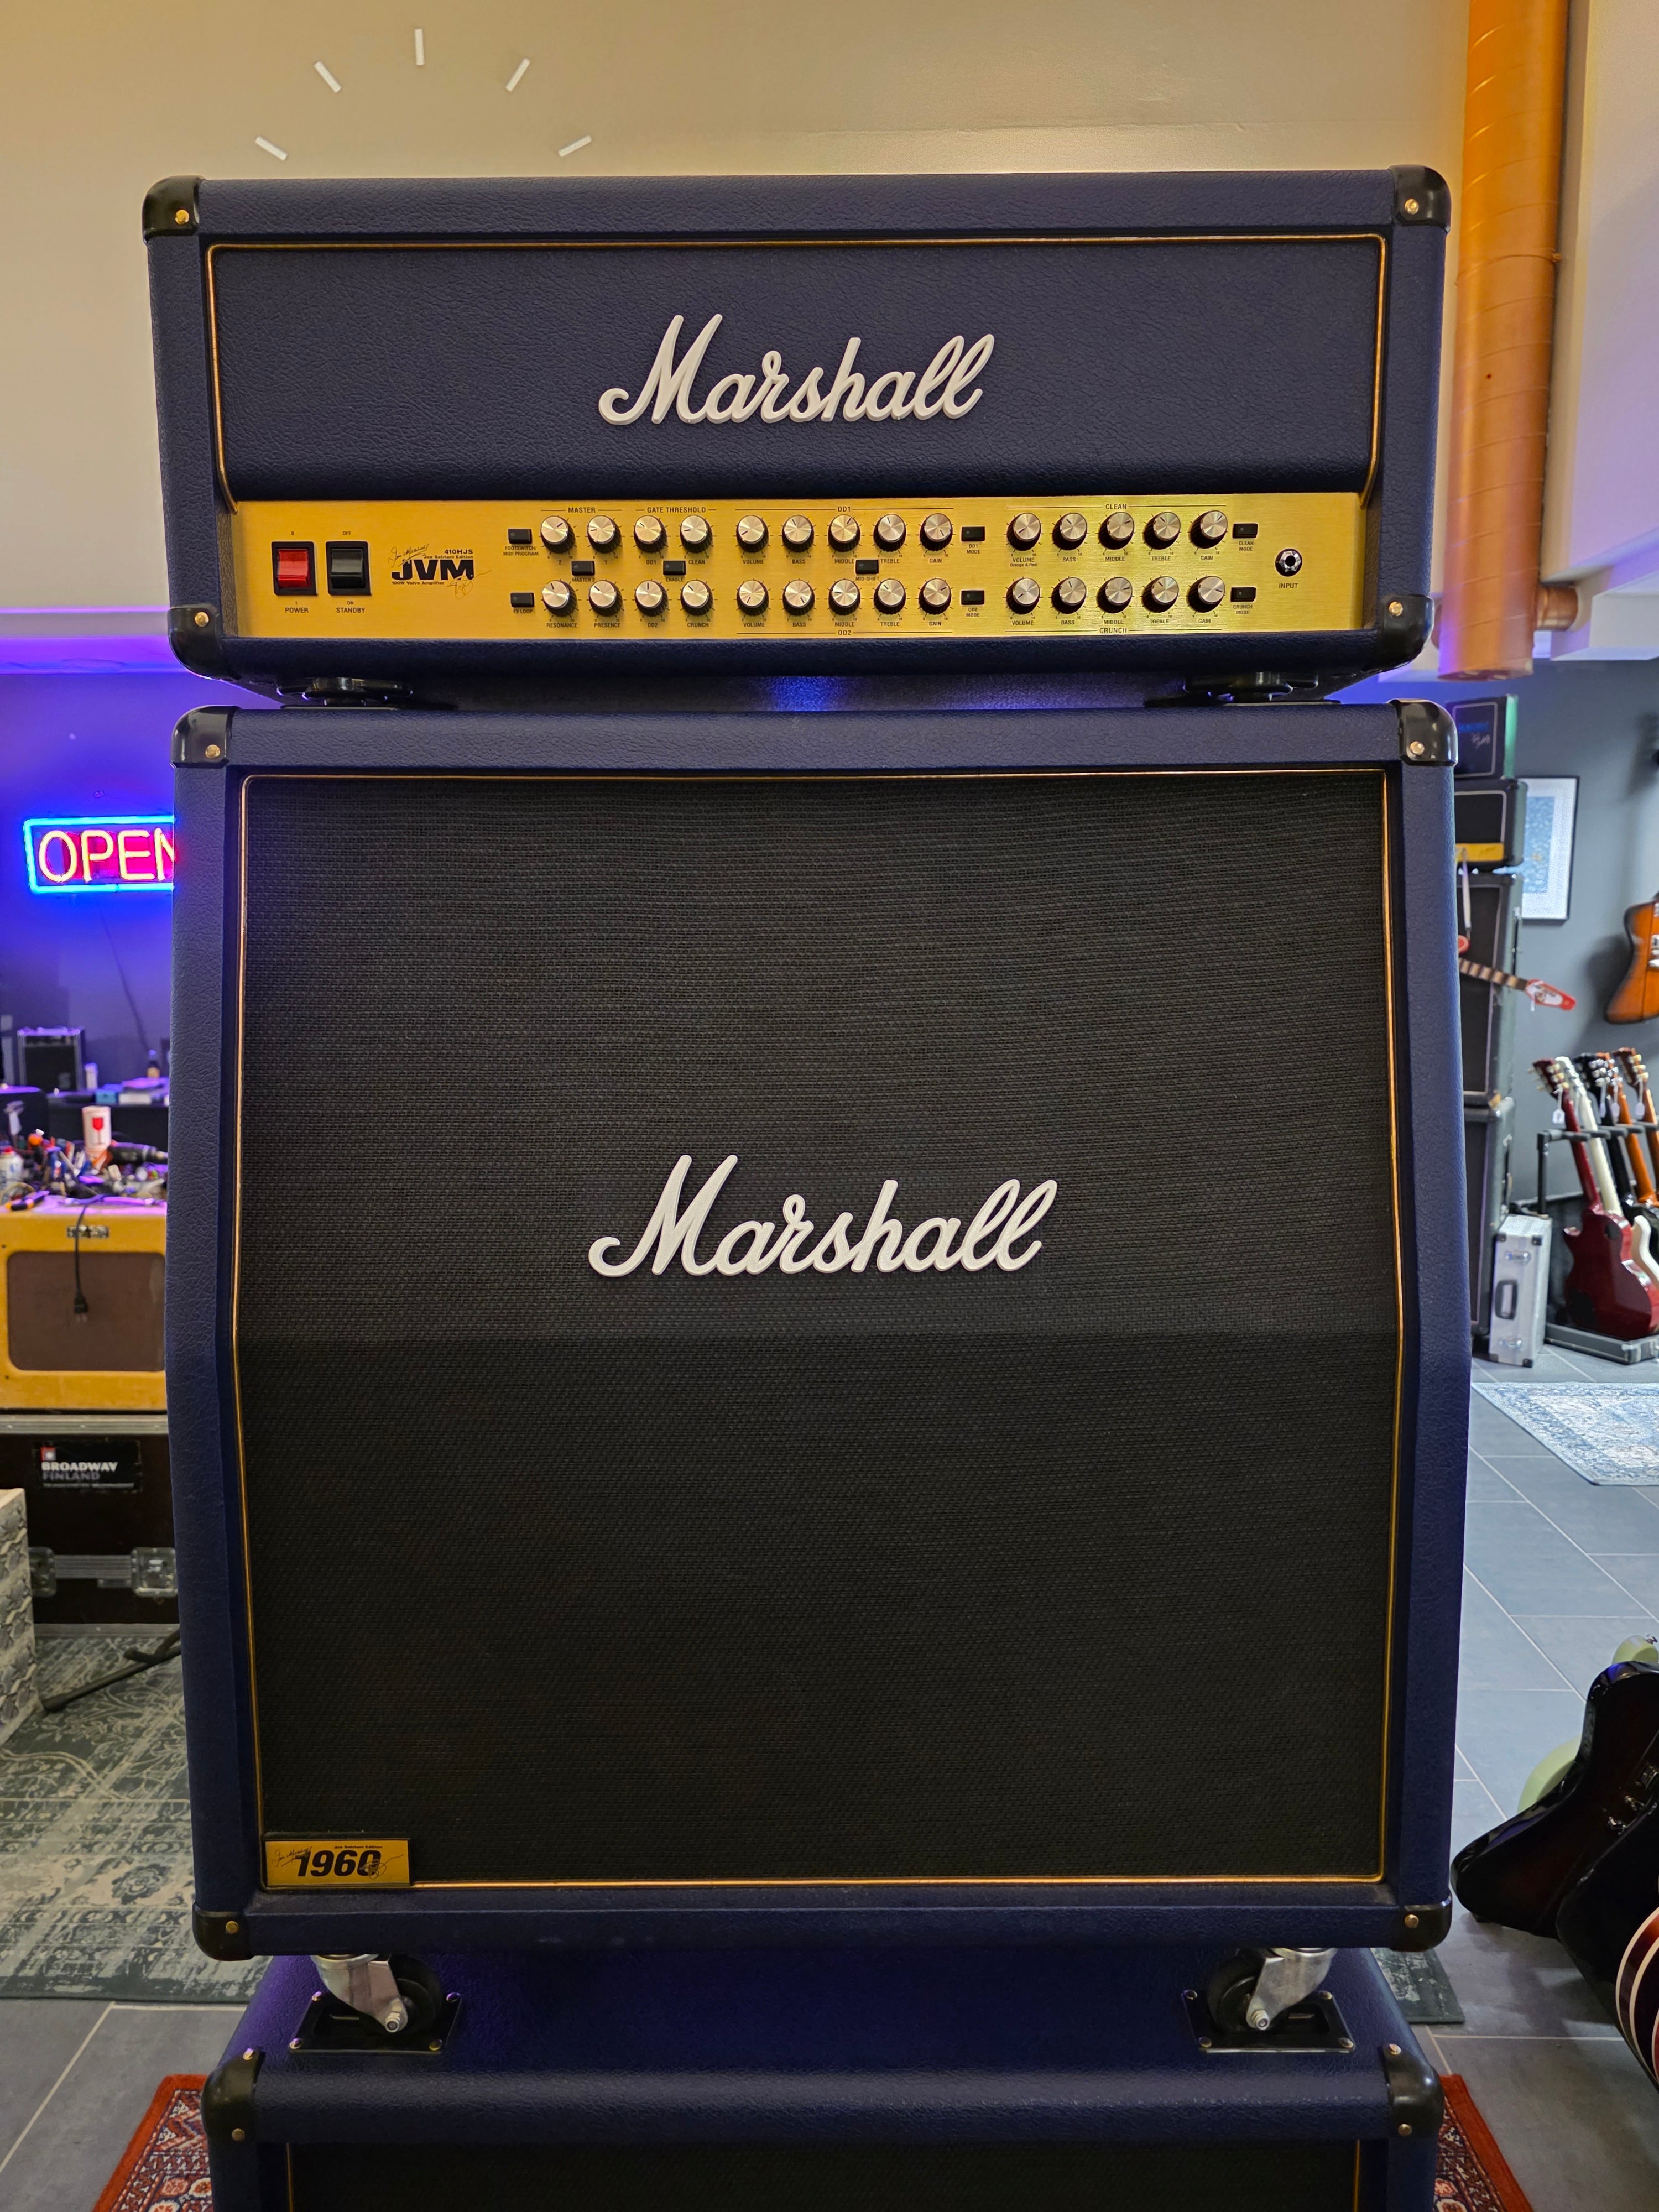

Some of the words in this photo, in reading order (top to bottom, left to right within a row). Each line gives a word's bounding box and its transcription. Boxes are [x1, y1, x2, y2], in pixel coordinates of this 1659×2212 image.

[598, 314, 994, 425] Marshall
[392, 560, 474, 580] JVM
[588, 1155, 1057, 1276] Marshall
[41, 1462, 118, 1472] BROADWAY
[42, 1472, 100, 1480] FINLAND
[293, 1850, 381, 1876] 1960
